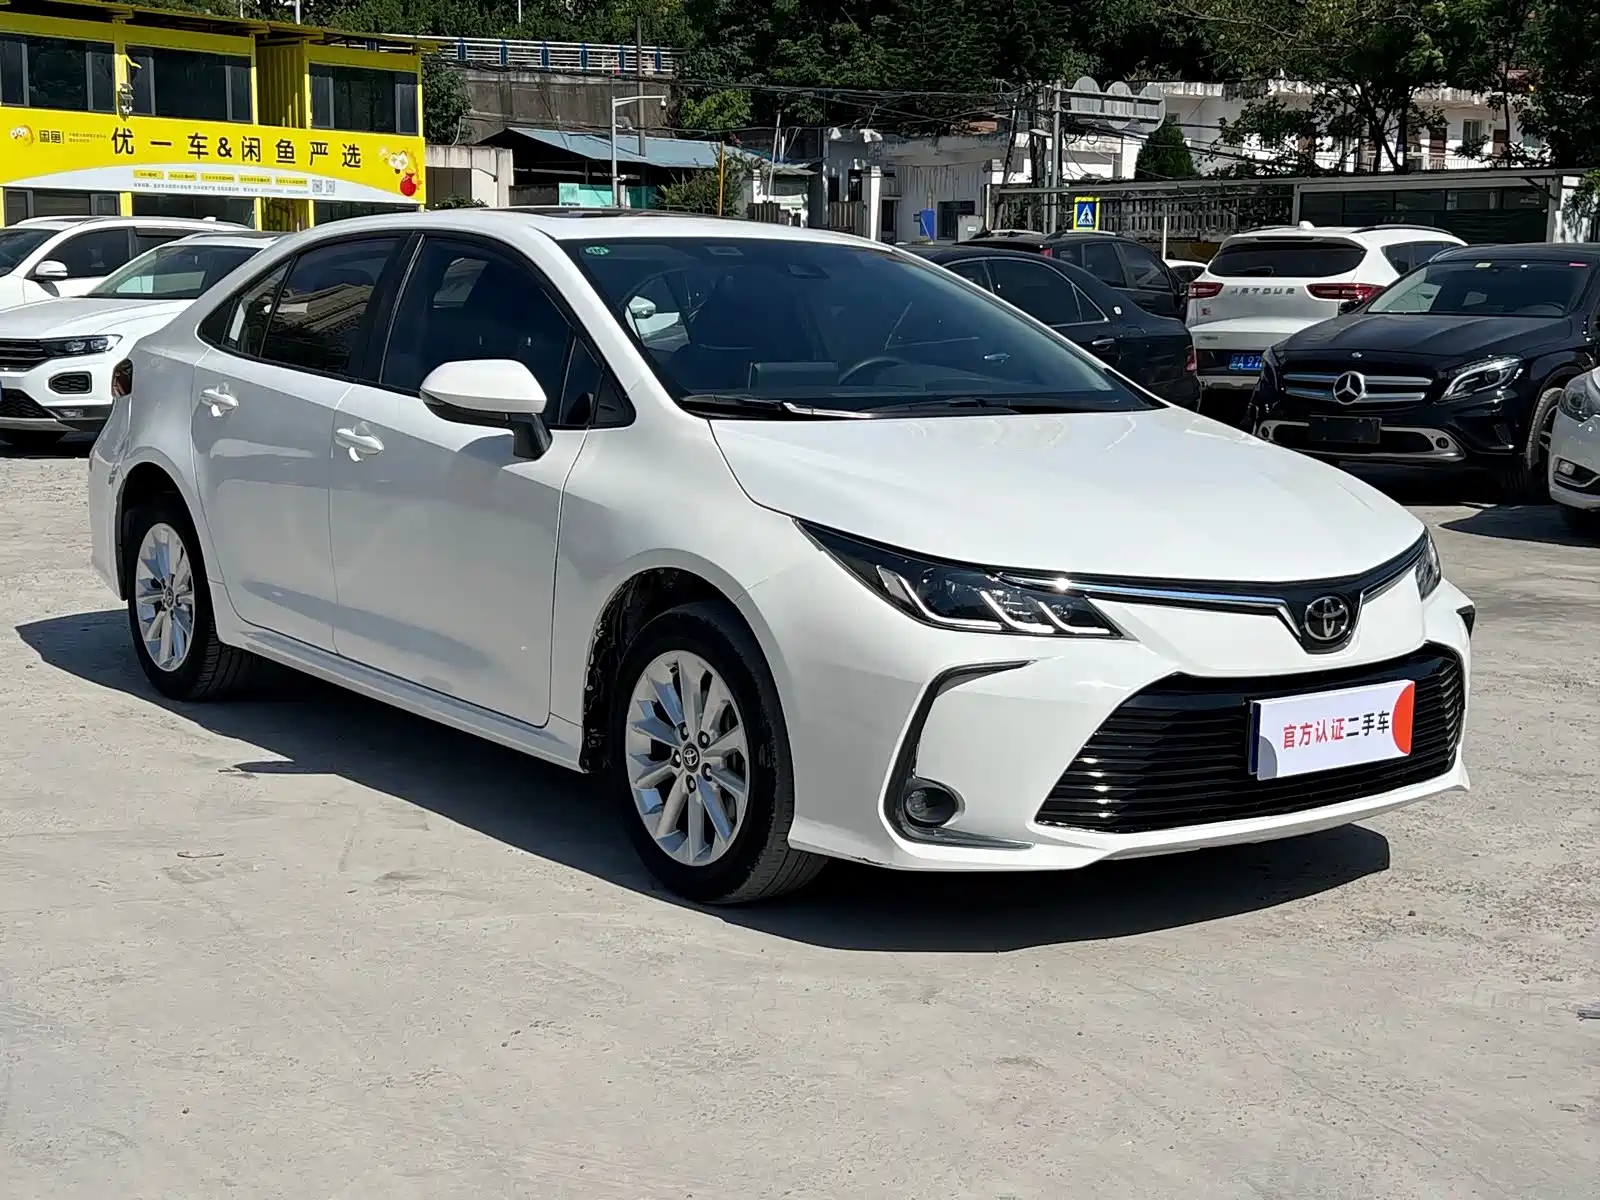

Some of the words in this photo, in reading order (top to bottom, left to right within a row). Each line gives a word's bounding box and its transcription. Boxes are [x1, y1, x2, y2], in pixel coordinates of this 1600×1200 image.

[111, 127, 362, 168] 优一车&闲鱼严选
[1283, 710, 1390, 749] 官方认证二手车
